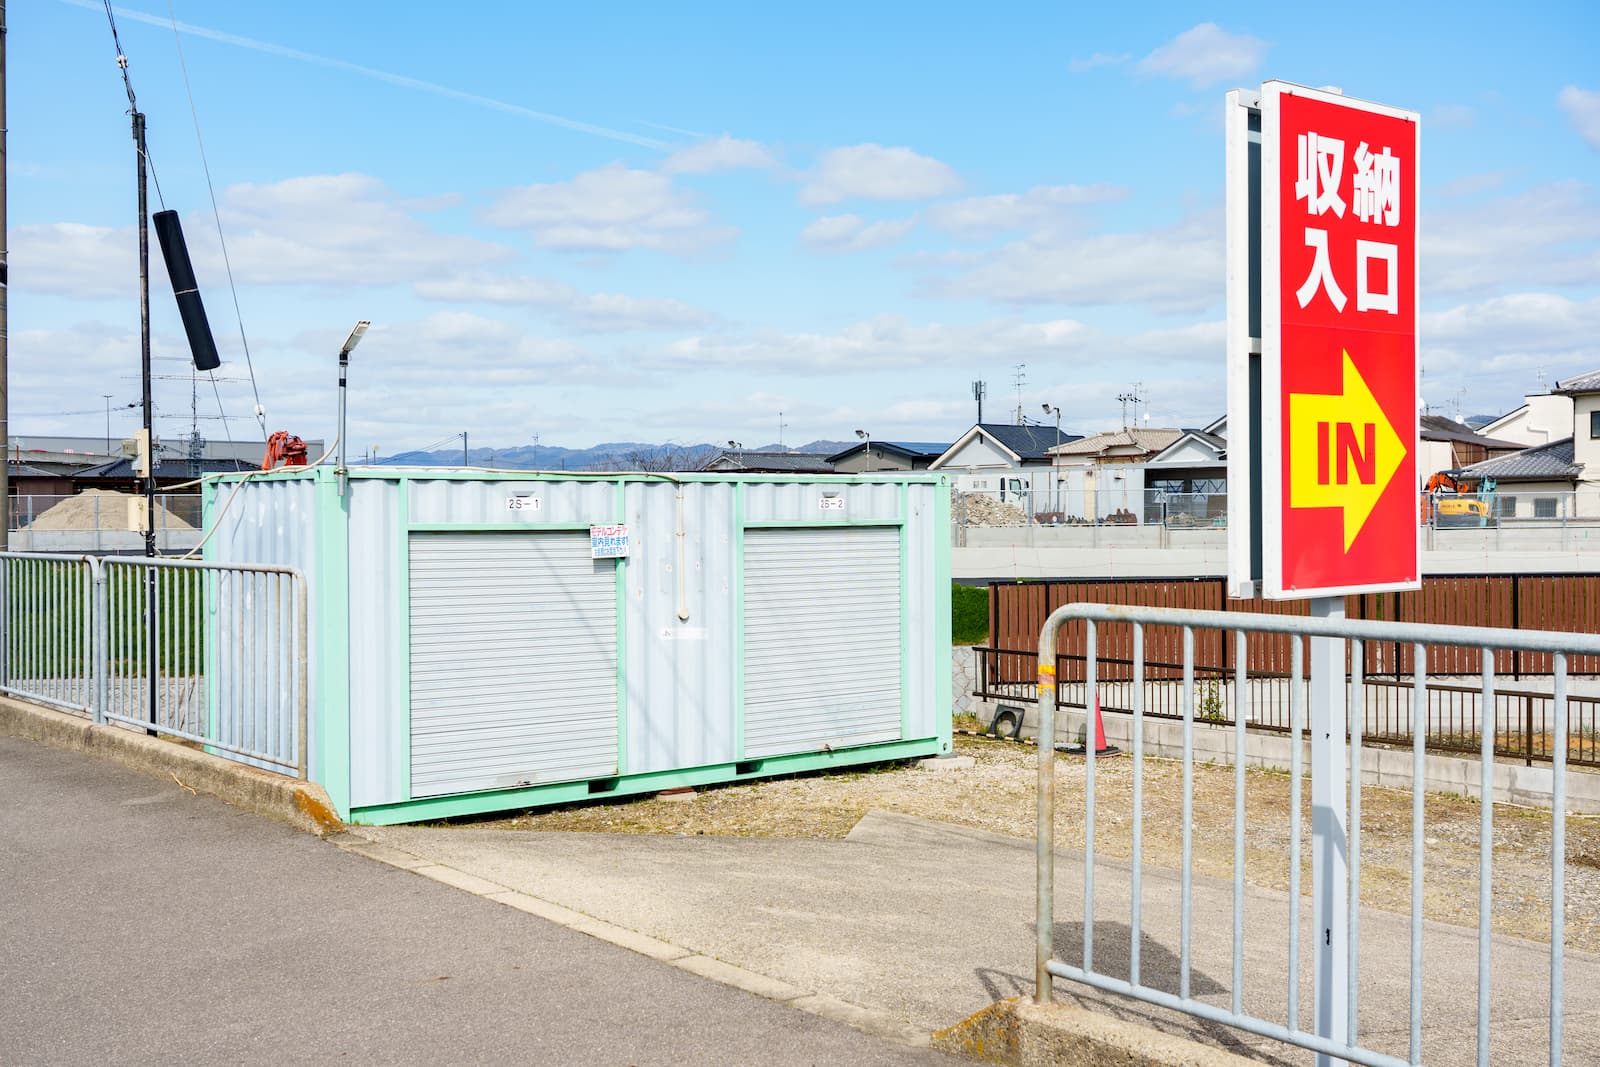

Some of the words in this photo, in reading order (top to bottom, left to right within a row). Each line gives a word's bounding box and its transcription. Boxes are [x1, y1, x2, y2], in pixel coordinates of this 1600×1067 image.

[1295, 131, 1400, 227] 収納
[1296, 227, 1398, 315] 入口
[1317, 421, 1376, 485] IN
